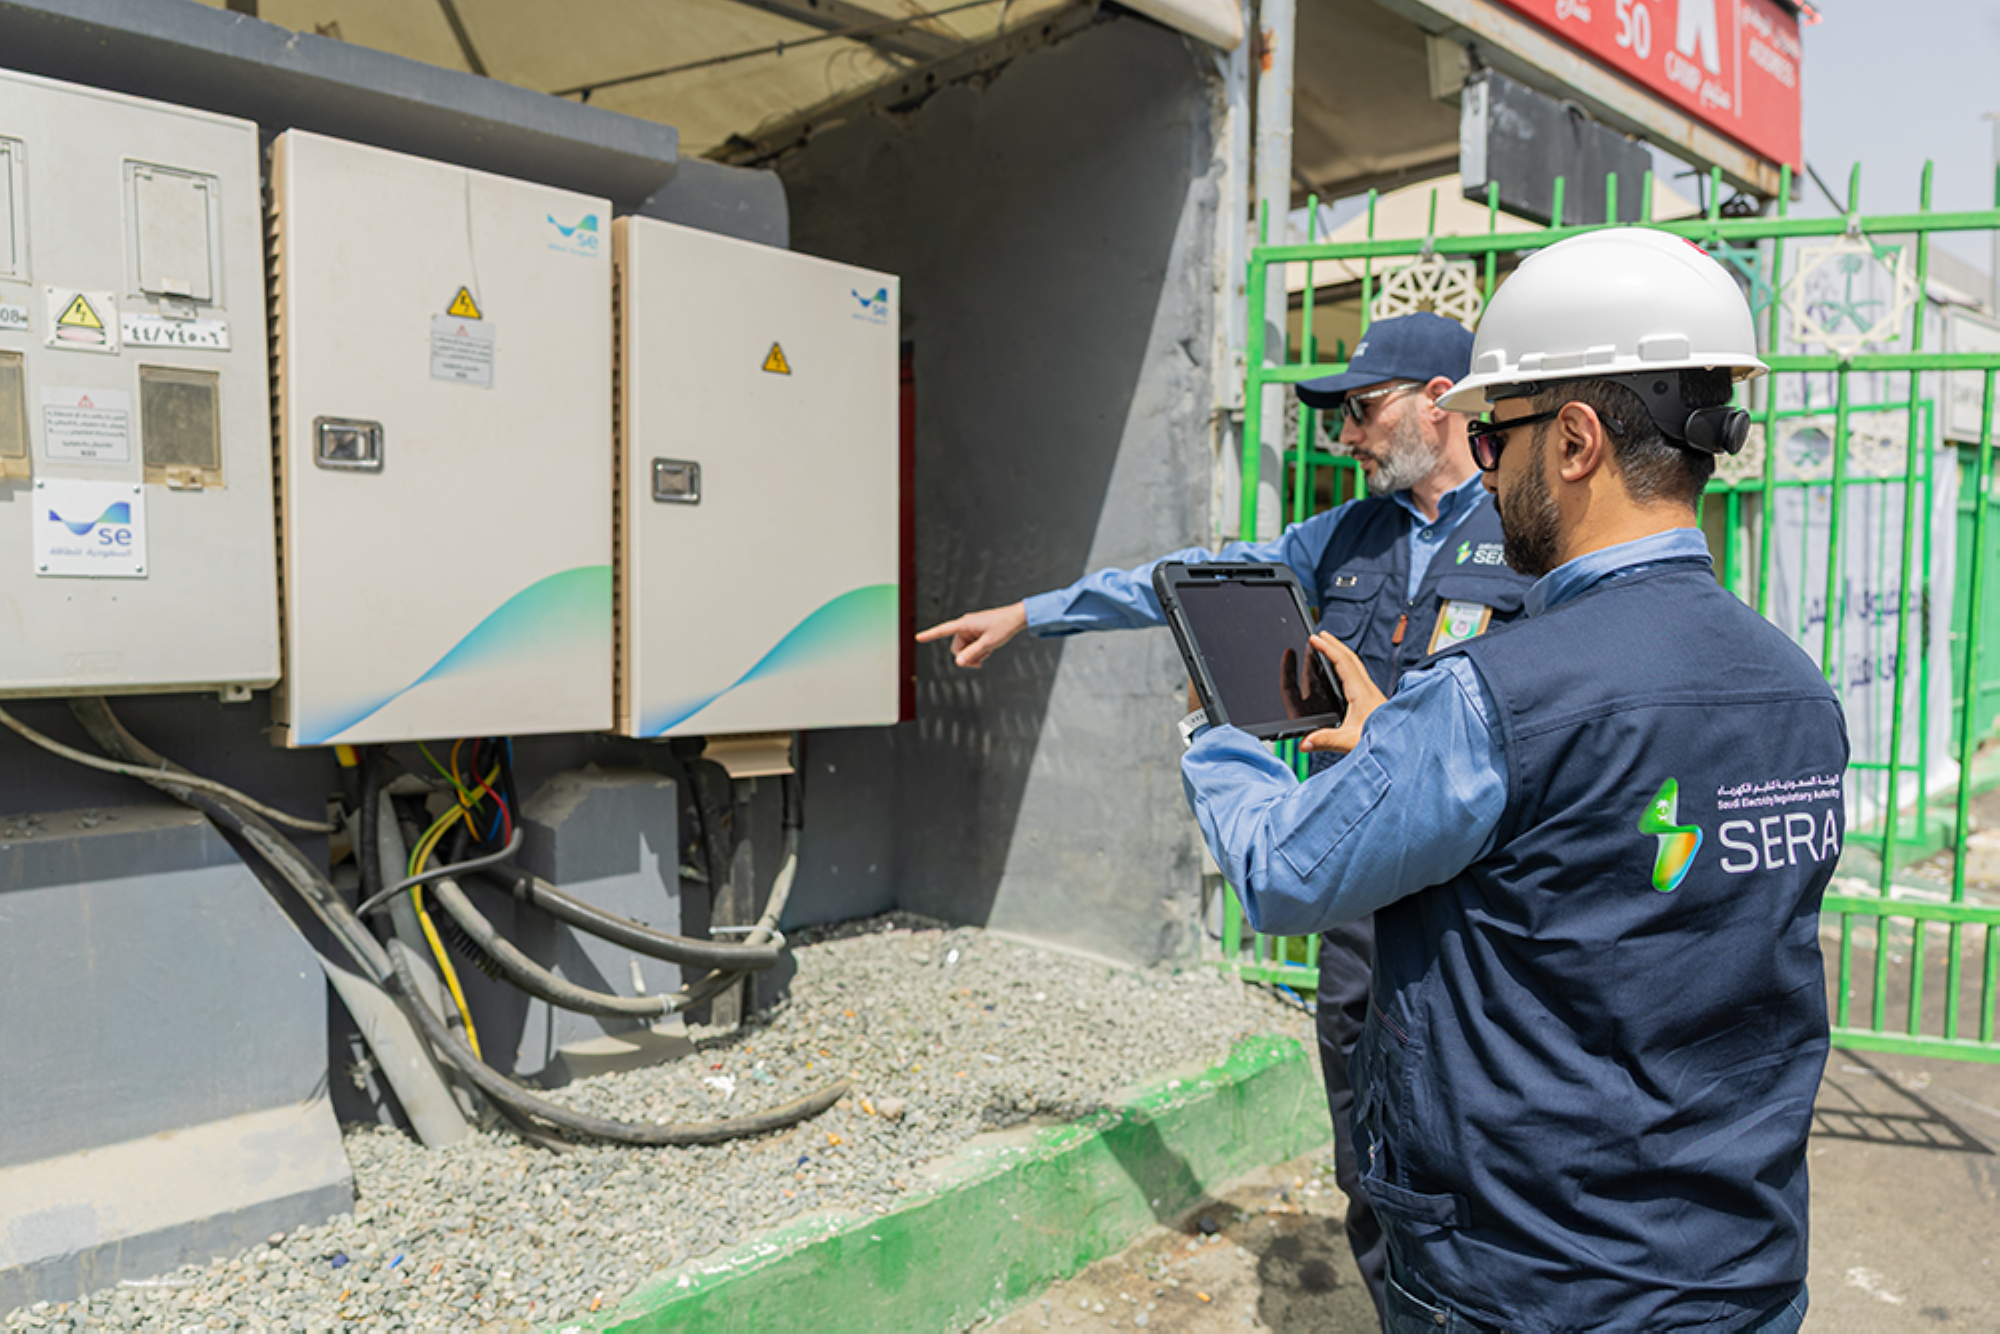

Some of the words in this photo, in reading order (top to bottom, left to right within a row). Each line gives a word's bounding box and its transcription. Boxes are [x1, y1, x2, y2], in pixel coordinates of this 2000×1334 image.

[1615, 0, 1651, 59] 50
[577, 232, 599, 249] se
[98, 527, 131, 546] se
[1718, 809, 1840, 874] SERA
